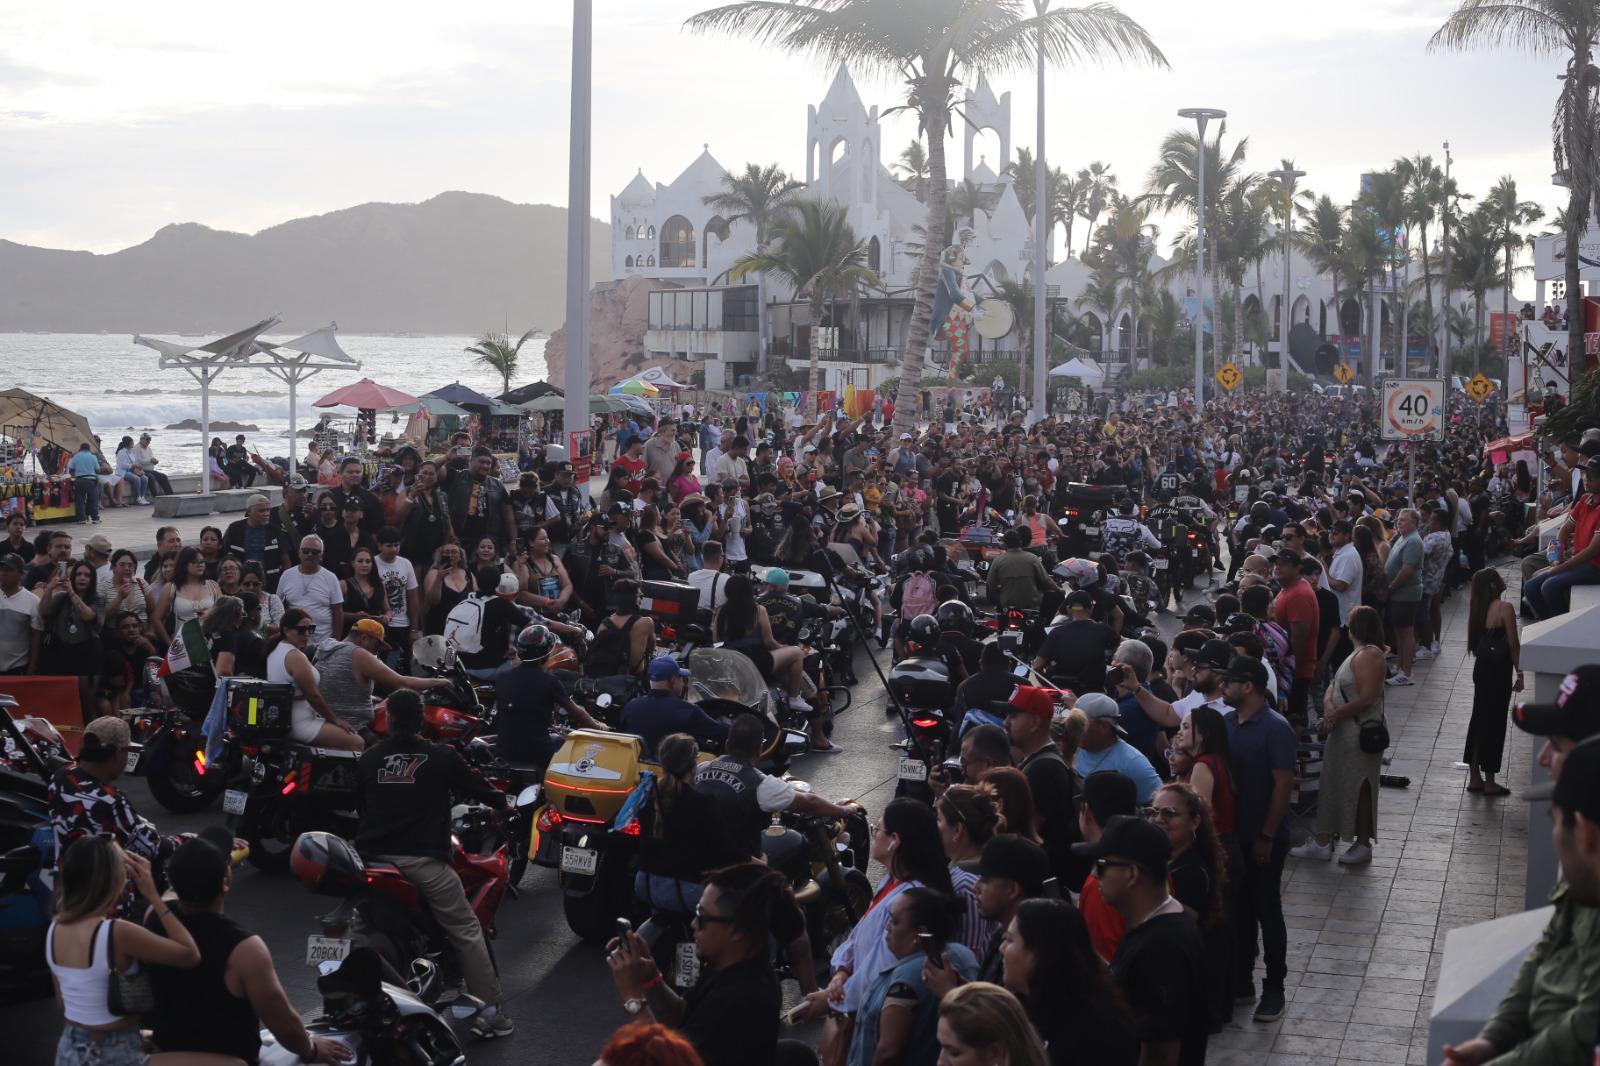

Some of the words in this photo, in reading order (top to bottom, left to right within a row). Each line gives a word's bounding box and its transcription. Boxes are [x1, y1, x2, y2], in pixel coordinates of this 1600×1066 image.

[1398, 395, 1429, 417] 40
[1161, 476, 1176, 489] 60
[697, 770, 743, 791] RIVERA
